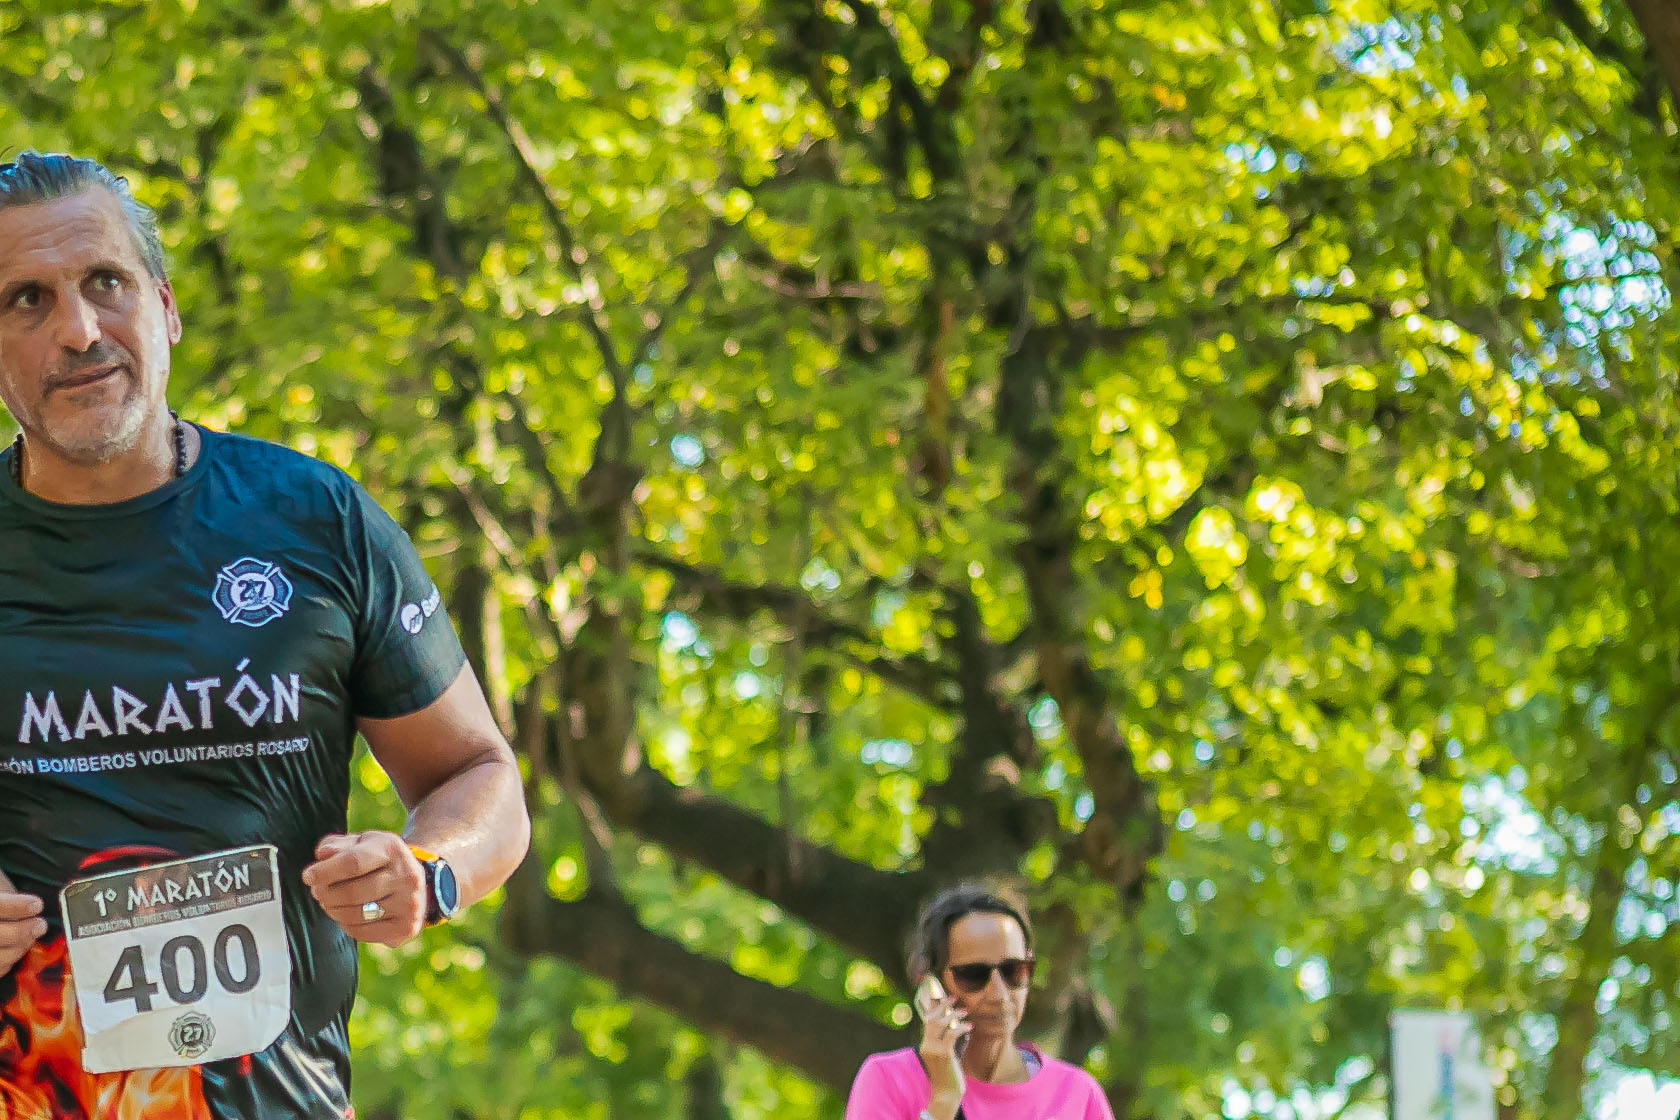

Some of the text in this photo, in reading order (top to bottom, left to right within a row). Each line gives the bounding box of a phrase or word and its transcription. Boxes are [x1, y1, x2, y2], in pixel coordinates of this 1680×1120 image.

[237, 579, 267, 603] 27
[19, 657, 302, 744] MARATÓN
[37, 752, 137, 774] BOMBEROS
[138, 743, 254, 766] VOLUNTARIOS
[127, 861, 251, 912] MARATÓN
[103, 923, 261, 1013] 400
